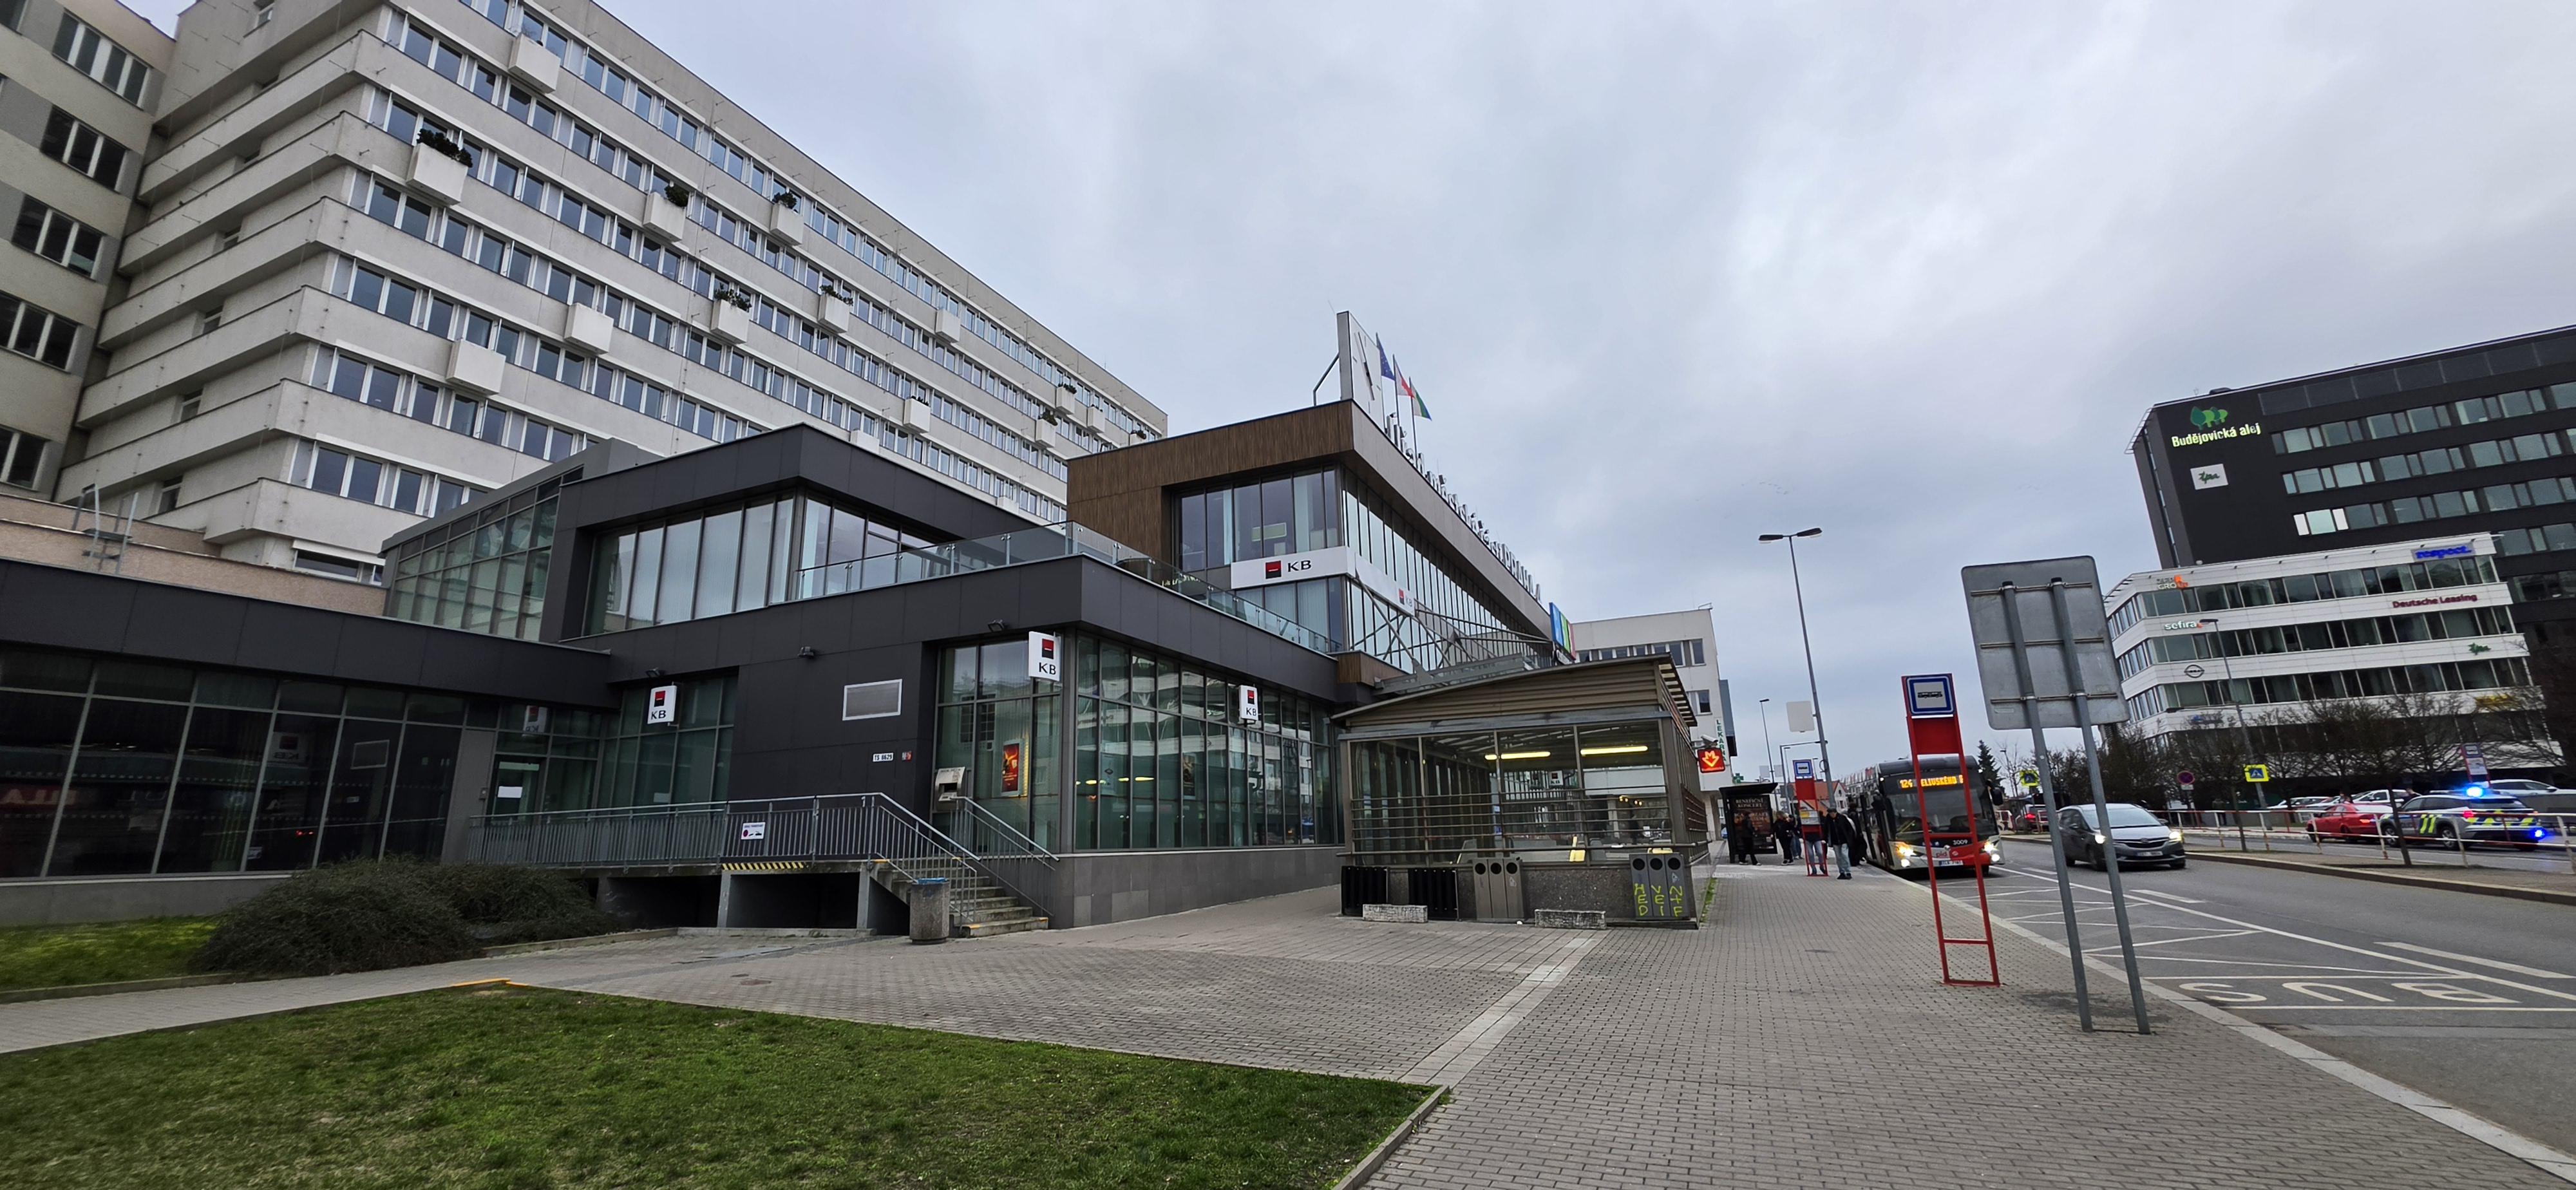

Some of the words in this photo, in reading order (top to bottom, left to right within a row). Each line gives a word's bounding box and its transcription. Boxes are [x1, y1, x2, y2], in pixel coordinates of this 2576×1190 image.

[2171, 426, 2237, 448] Budějovická
[2239, 422, 2261, 436] alej
[1287, 560, 1312, 572] KB
[2392, 598, 2438, 608] Deutsche
[2439, 594, 2477, 603] Leasing
[2164, 620, 2197, 630] sefira
[1039, 662, 1056, 675] KB
[650, 710, 667, 719] KB
[1246, 707, 1256, 716] KB
[1899, 779, 1913, 788] 124
[2179, 982, 2523, 1004] BUS
